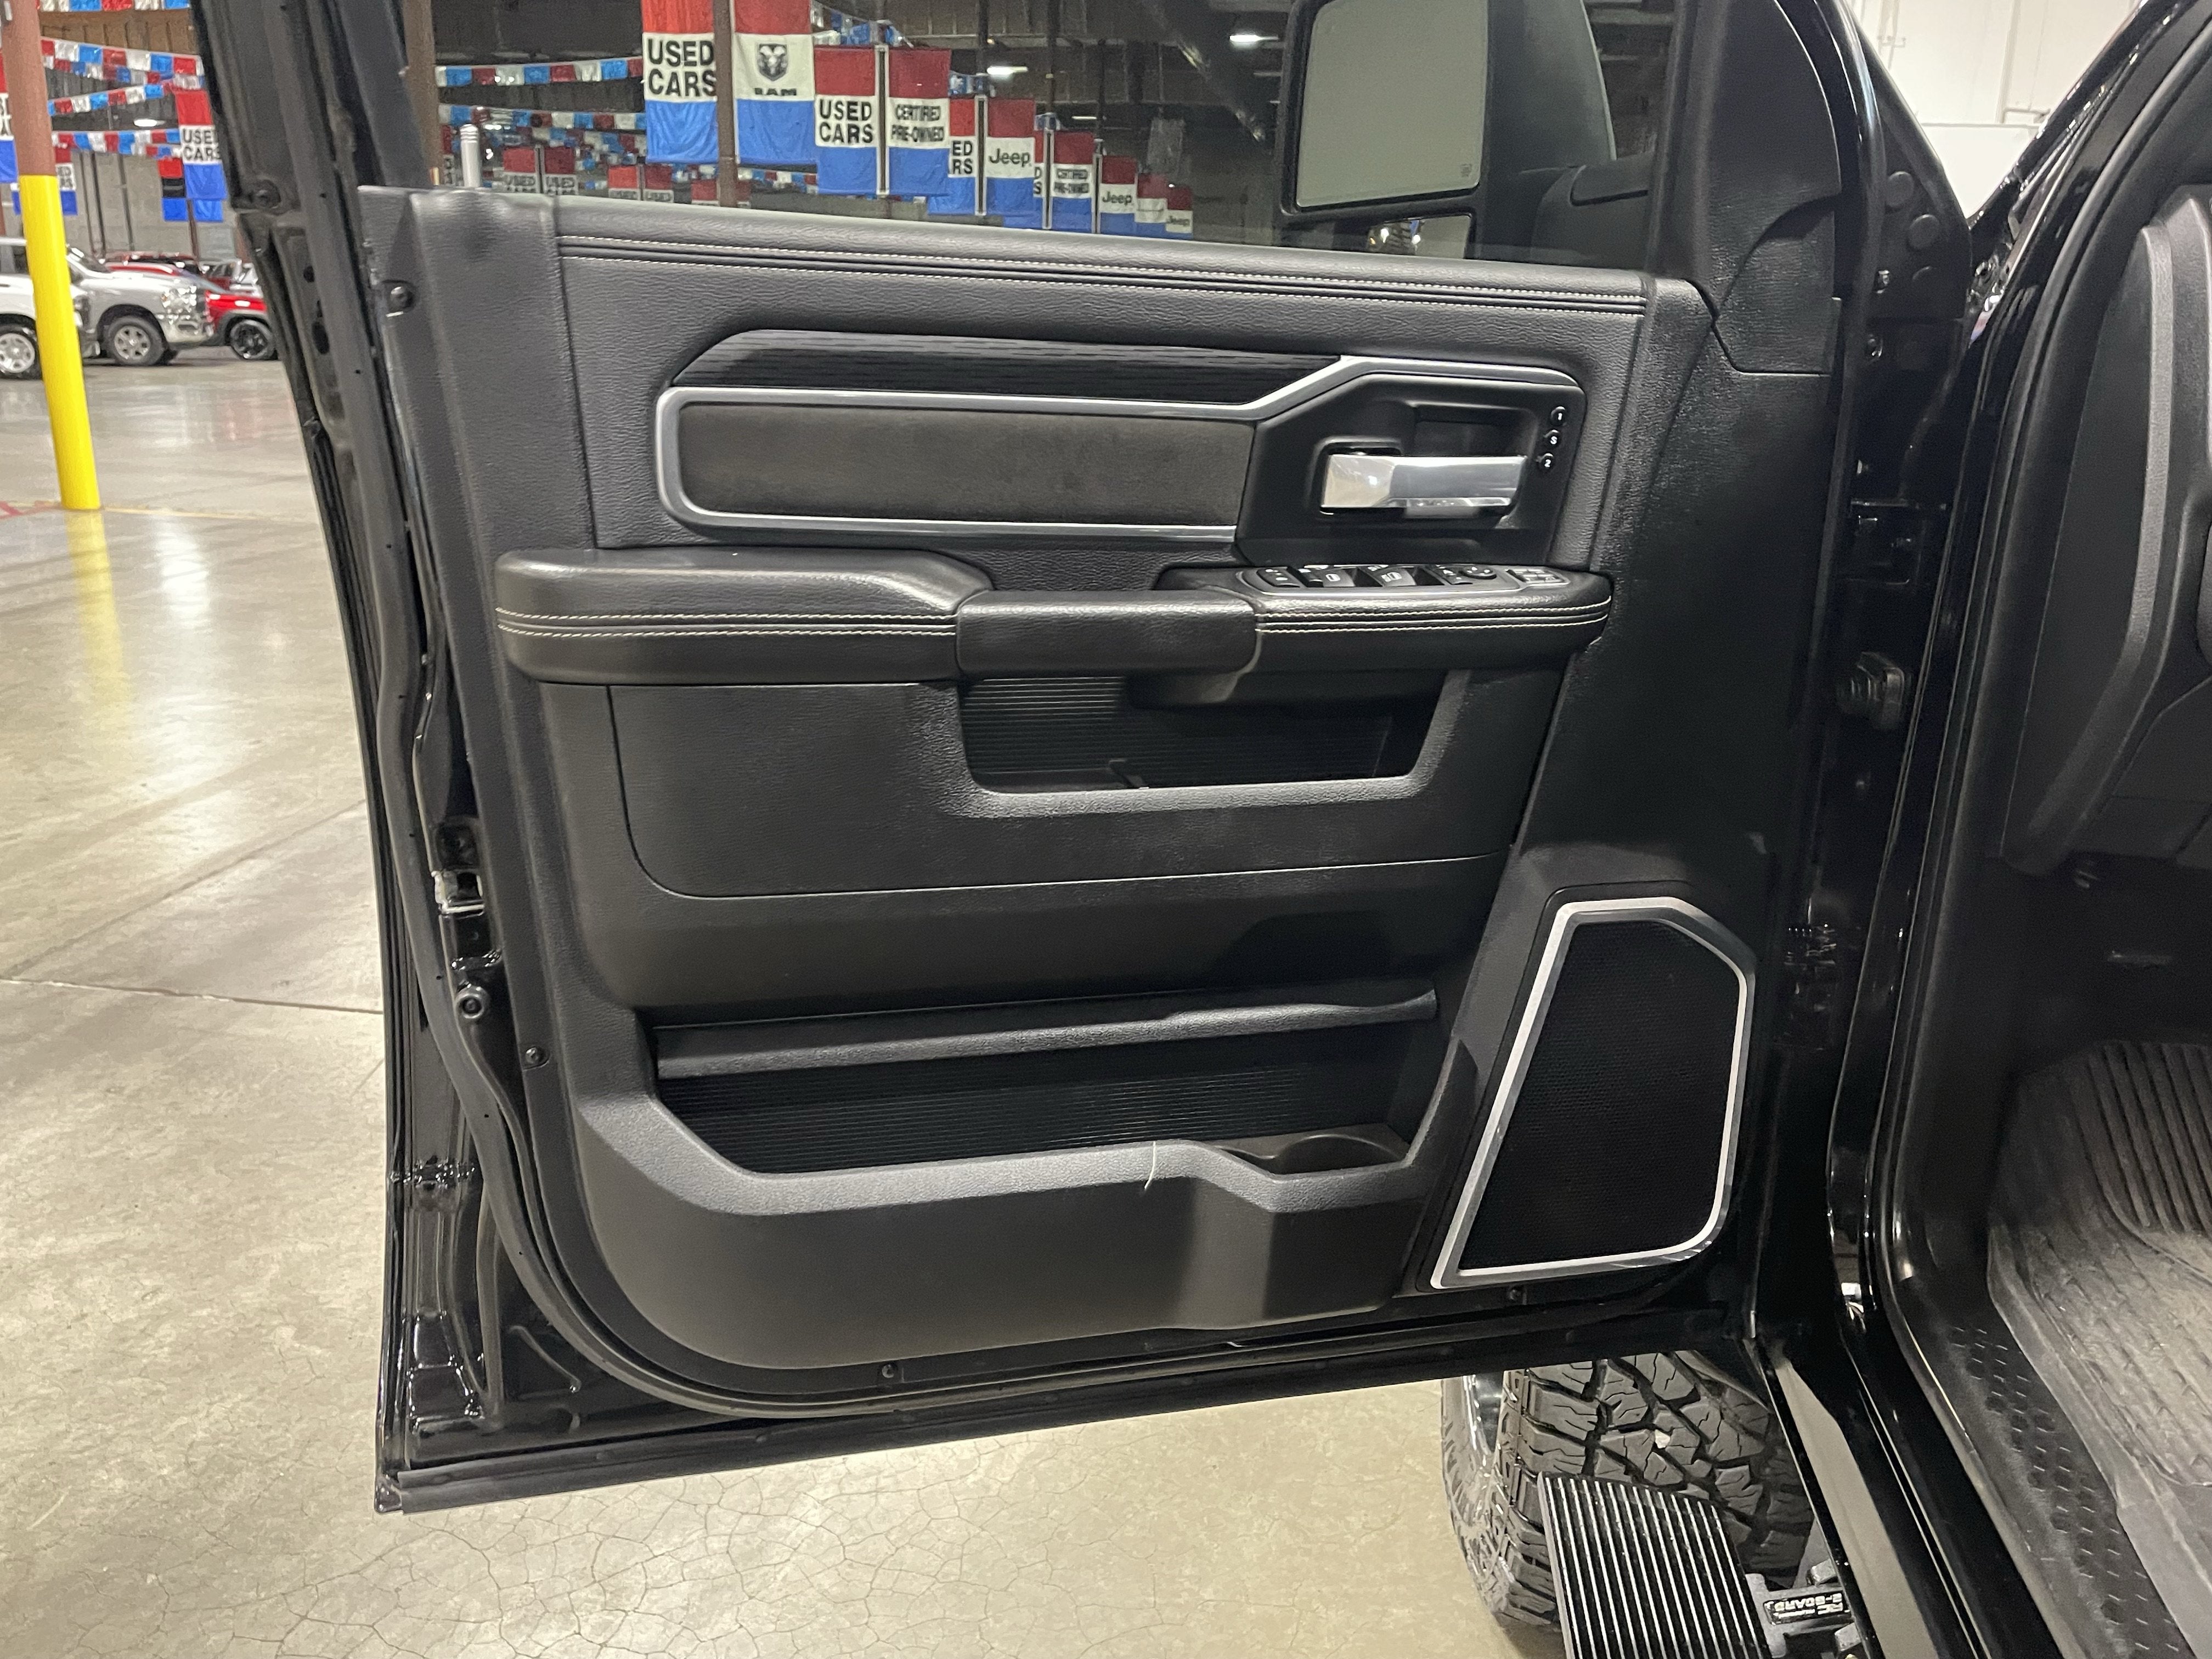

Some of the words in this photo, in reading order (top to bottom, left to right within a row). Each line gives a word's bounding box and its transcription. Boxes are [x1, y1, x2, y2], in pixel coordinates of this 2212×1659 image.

[648, 38, 714, 67] USED
[648, 69, 716, 97] CARS
[819, 101, 872, 121] USED
[819, 122, 874, 144] CARS
[952, 140, 973, 156] ED
[989, 148, 1030, 167] Jeep
[952, 159, 973, 174] RS
[1102, 192, 1132, 206] Jeep
[1550, 436, 1558, 445] S
[1544, 459, 1551, 467] 2
